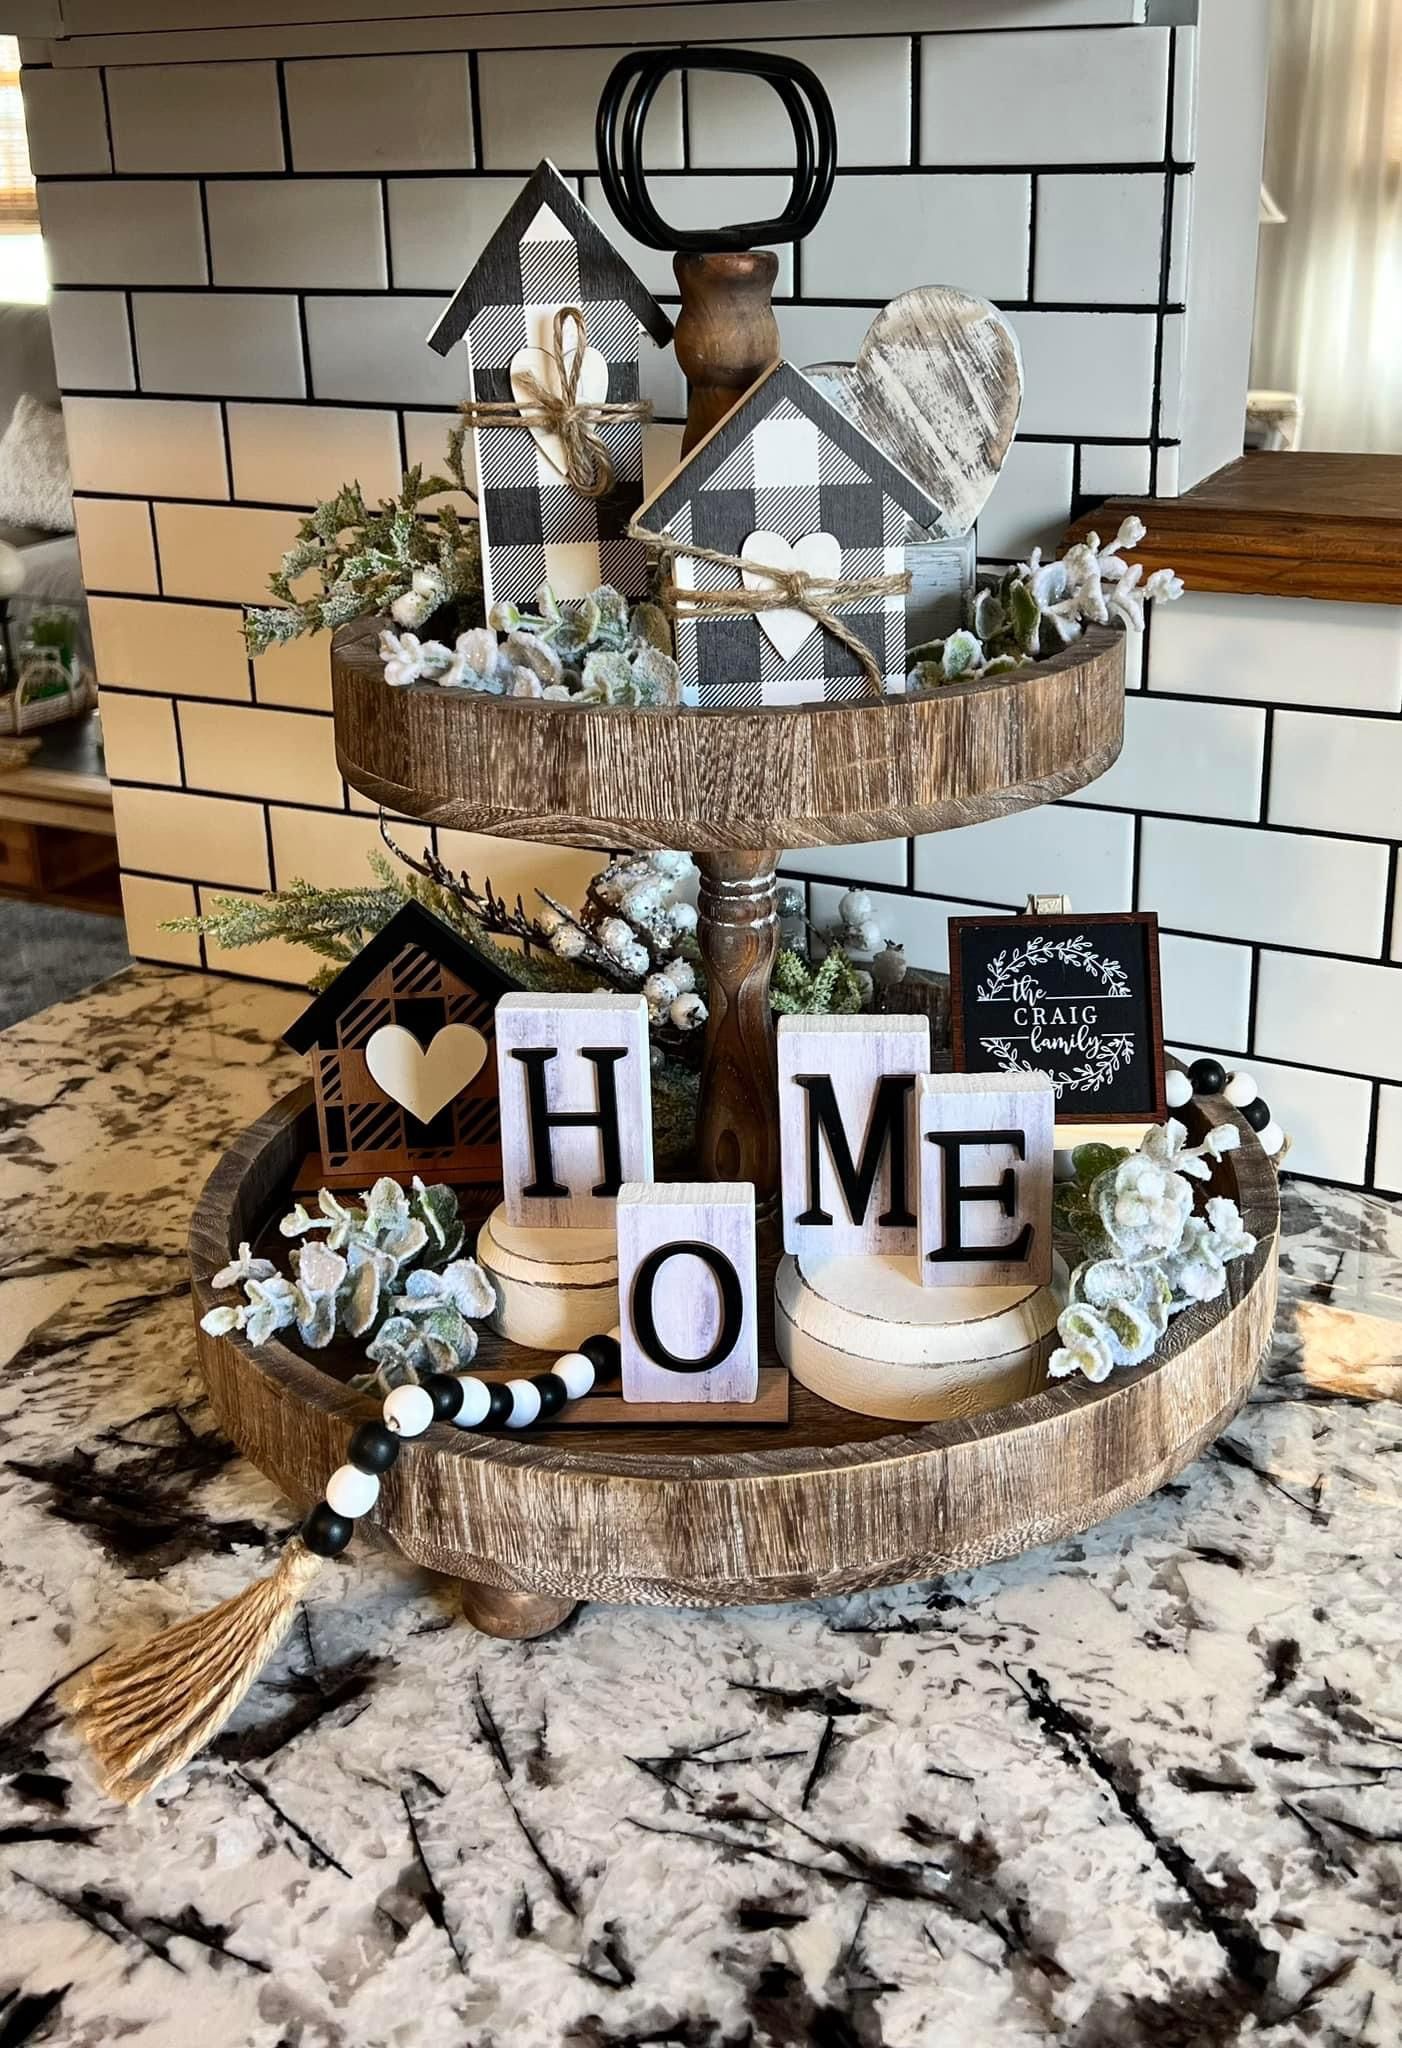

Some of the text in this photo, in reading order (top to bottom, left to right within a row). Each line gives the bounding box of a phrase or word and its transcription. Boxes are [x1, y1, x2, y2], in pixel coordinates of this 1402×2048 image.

[1003, 975, 1047, 1006] the
[1014, 1006, 1098, 1026] CRAIG
[1030, 1025, 1101, 1059] family
